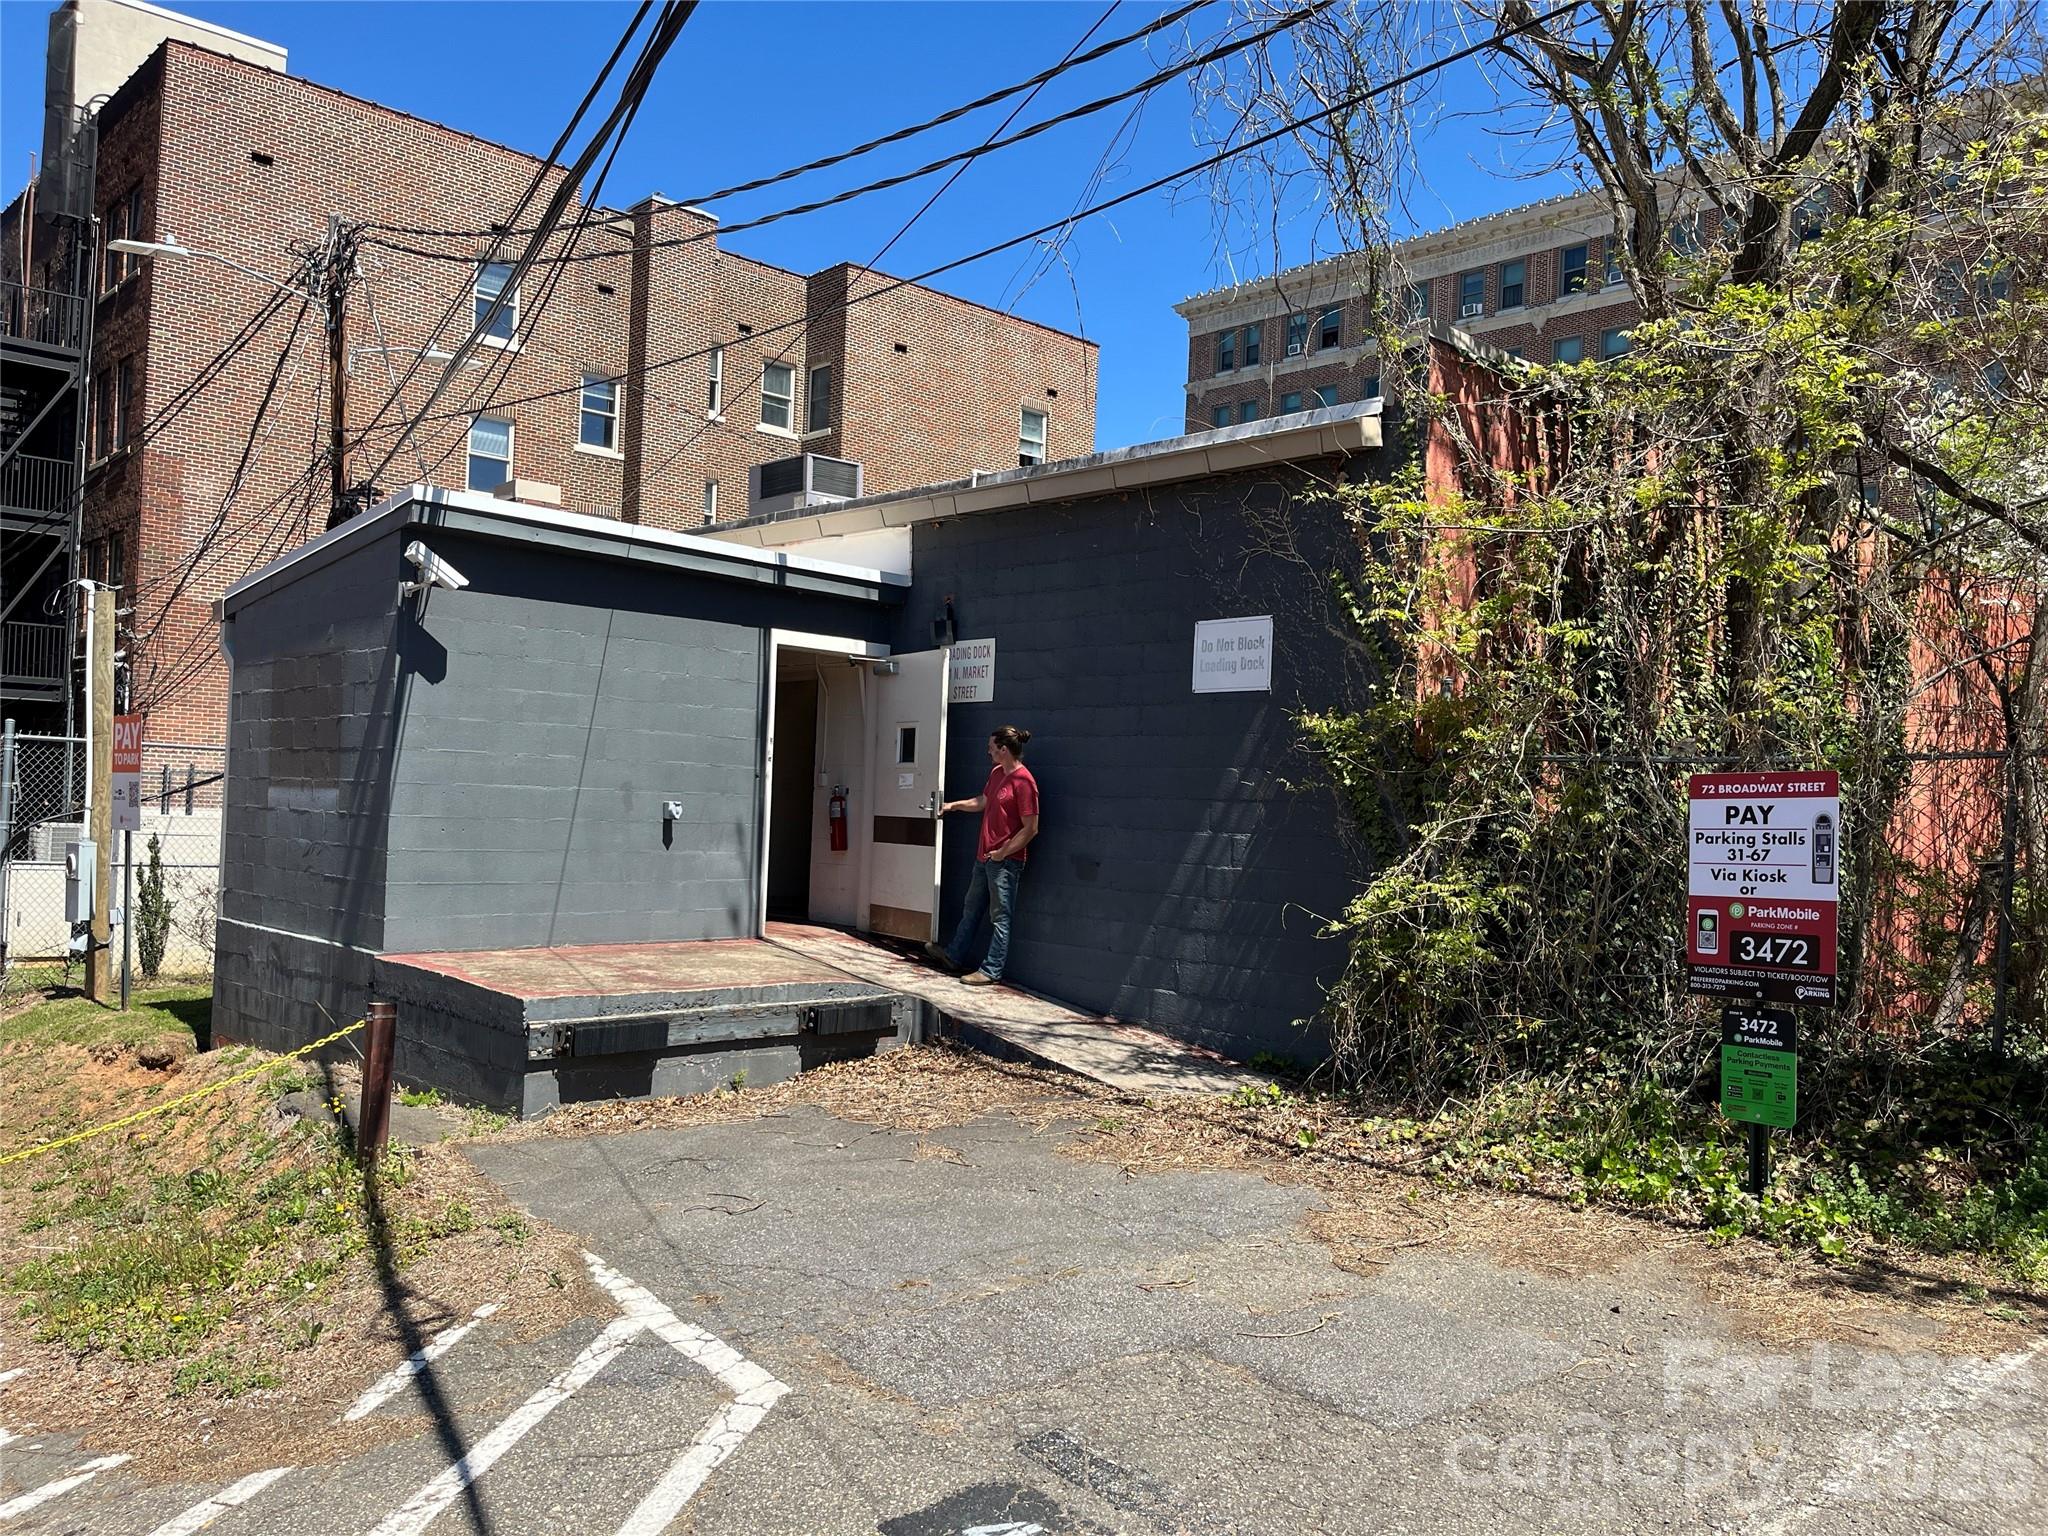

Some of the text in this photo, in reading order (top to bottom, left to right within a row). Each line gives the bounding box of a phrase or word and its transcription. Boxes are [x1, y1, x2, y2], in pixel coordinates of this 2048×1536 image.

[1201, 635, 1265, 653] Do Not Block
[949, 644, 991, 661] OADING DOCK
[963, 665, 989, 679] MARKET
[1200, 655, 1265, 674] Loading Dock
[953, 685, 977, 699] STREET
[114, 722, 140, 750] PAY
[114, 752, 140, 765] TO PARK
[1701, 782, 1826, 794] 72 BROADWAY STREET
[1725, 805, 1775, 825] PAY
[1695, 831, 1806, 848] Parking Stalls
[1727, 848, 1771, 862] 31-67
[1711, 868, 1788, 883] Via Kiosk
[1739, 884, 1758, 896] or
[1748, 905, 1820, 921] ParkMobile
[1750, 922, 1776, 930] PARKING
[1740, 936, 1808, 965] 3472
[1693, 966, 1829, 984] VIOLATORS SUBJECT TO TICKET/BOOT/TOW
[1739, 1017, 1778, 1035] 3472
[1743, 1035, 1783, 1047] ParkMobile
[1726, 1056, 1791, 1071] Parking Payments
[1737, 1050, 1780, 1062] Contactless
